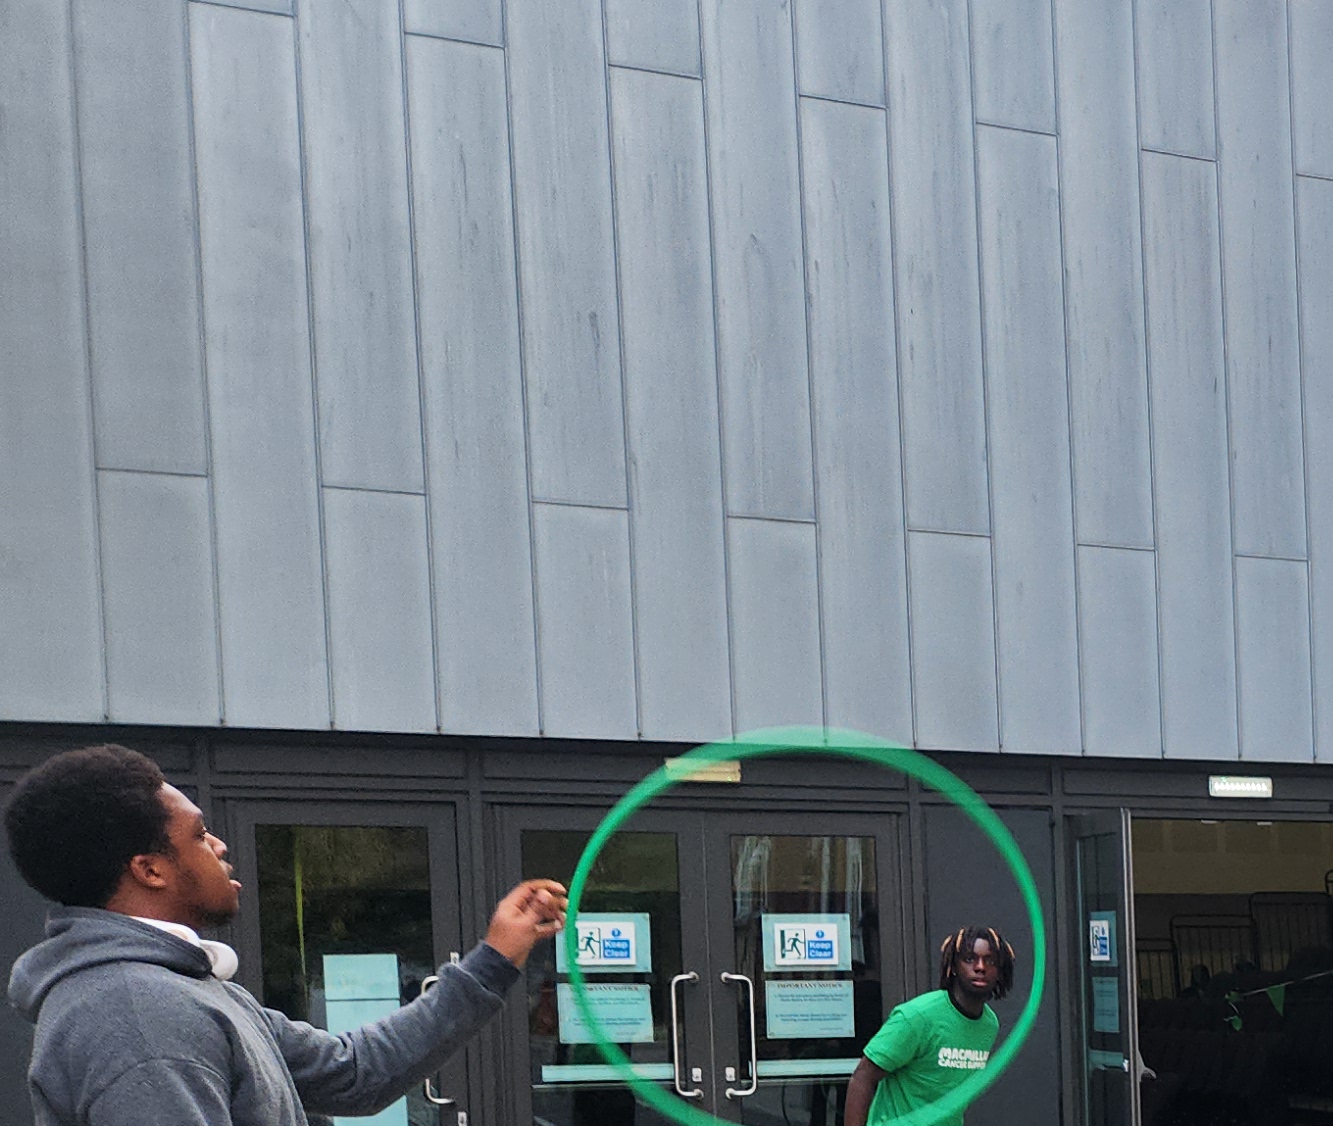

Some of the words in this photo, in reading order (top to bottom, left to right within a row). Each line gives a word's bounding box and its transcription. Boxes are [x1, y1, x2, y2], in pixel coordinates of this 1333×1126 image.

[604, 940, 628, 949] Keep
[809, 941, 832, 950] Keep
[604, 949, 628, 957] Clear
[809, 949, 832, 957] Clear
